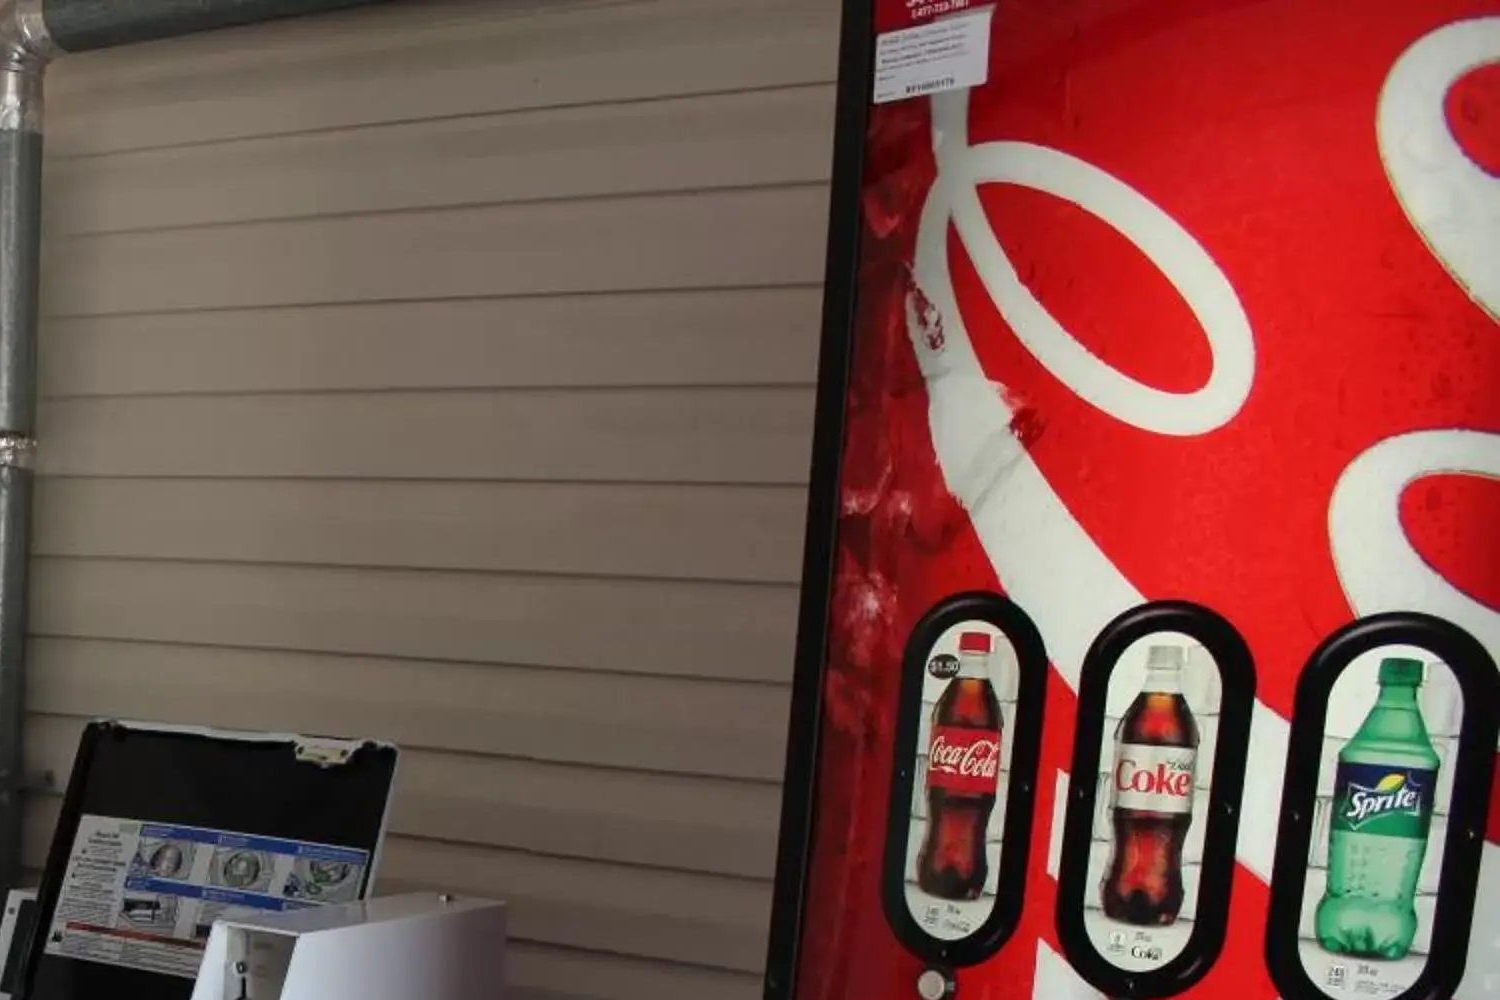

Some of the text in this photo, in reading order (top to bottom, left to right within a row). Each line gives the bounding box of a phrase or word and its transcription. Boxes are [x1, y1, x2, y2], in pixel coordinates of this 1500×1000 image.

[930, 661, 958, 672] $1.50
[929, 735, 998, 777] Coca-Cola
[1116, 759, 1191, 797] Coke
[1346, 787, 1417, 819] Sprite
